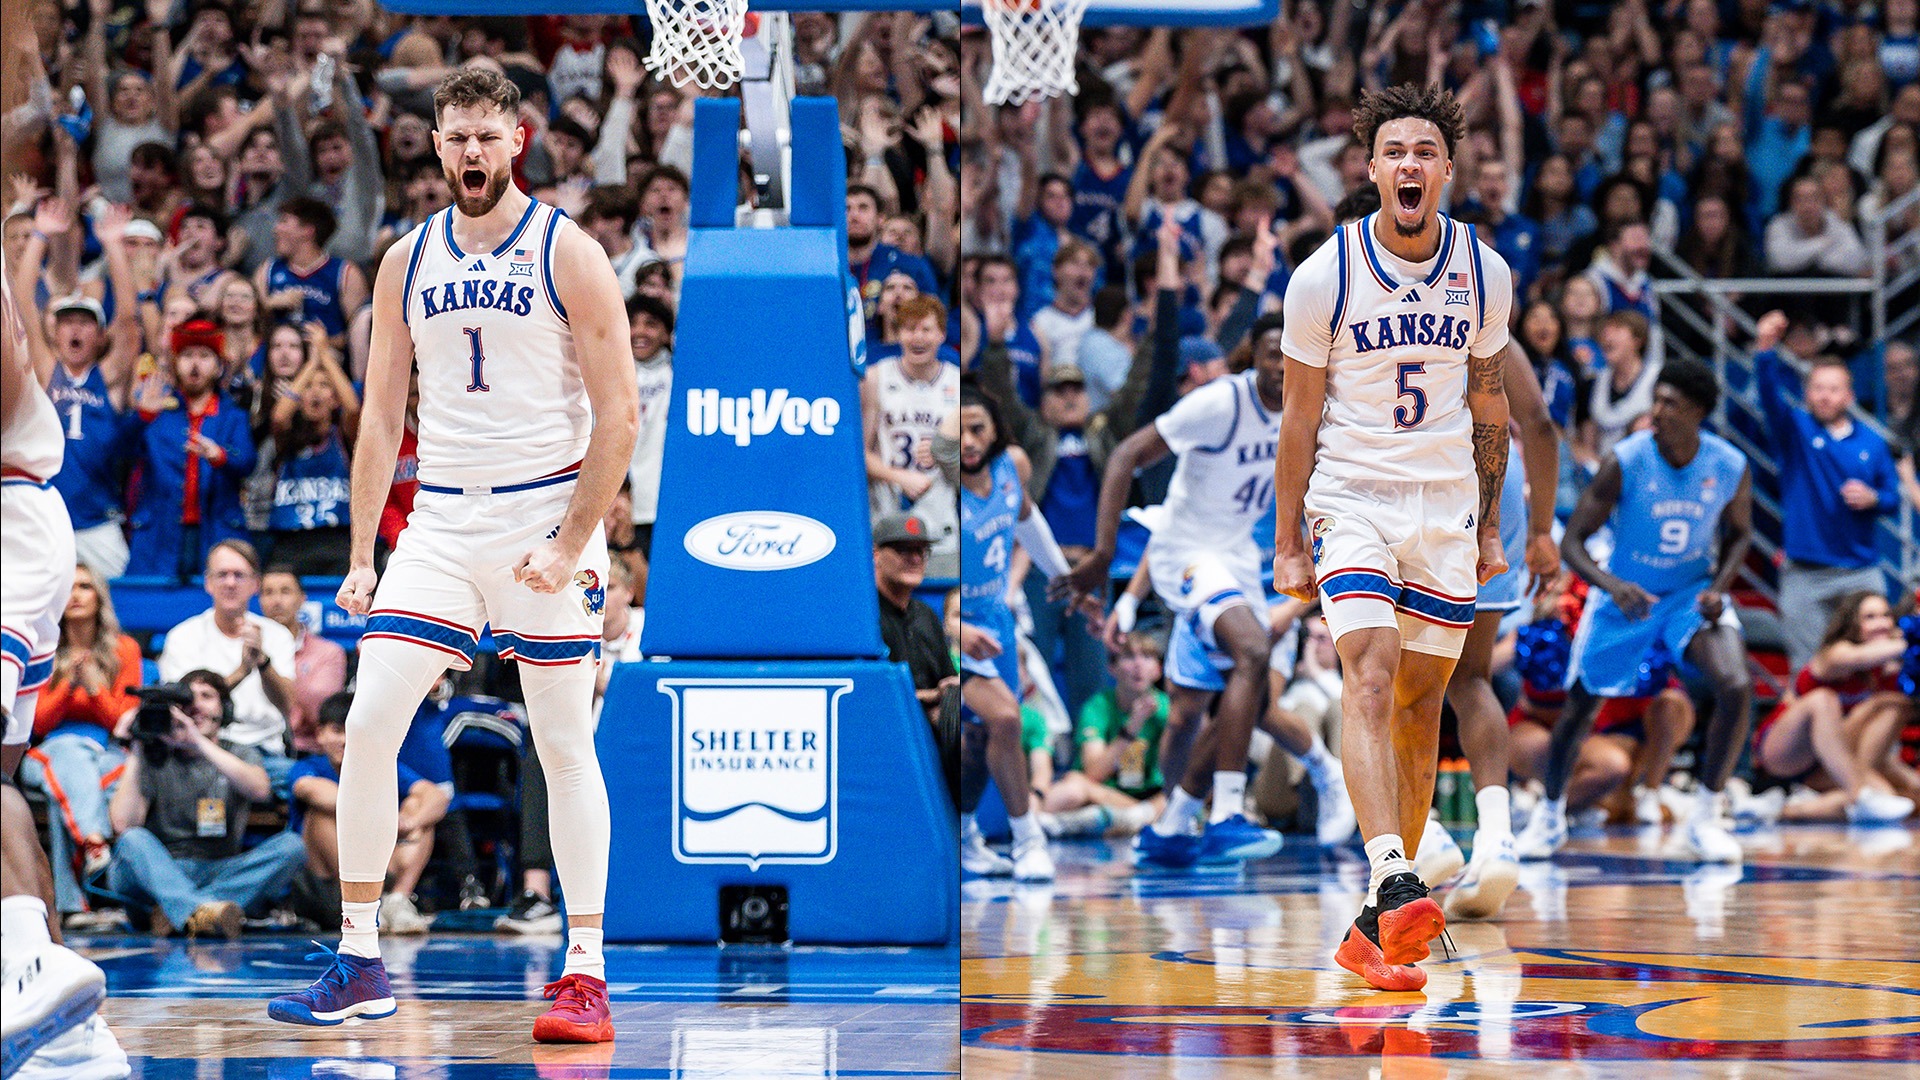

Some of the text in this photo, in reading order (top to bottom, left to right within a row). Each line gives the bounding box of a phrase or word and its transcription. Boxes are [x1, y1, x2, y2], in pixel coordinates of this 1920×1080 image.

[421, 279, 535, 319] KANSAS
[1349, 313, 1470, 353] KANSAS
[463, 327, 490, 392] 1
[1393, 361, 1430, 429] 5
[65, 403, 84, 440] 1
[687, 388, 840, 446] HyVee
[718, 522, 802, 556] Ford
[983, 535, 1007, 572] 4
[1658, 519, 1690, 554] 9
[691, 729, 817, 752] SHELTER
[691, 756, 817, 771] INSURANCE
